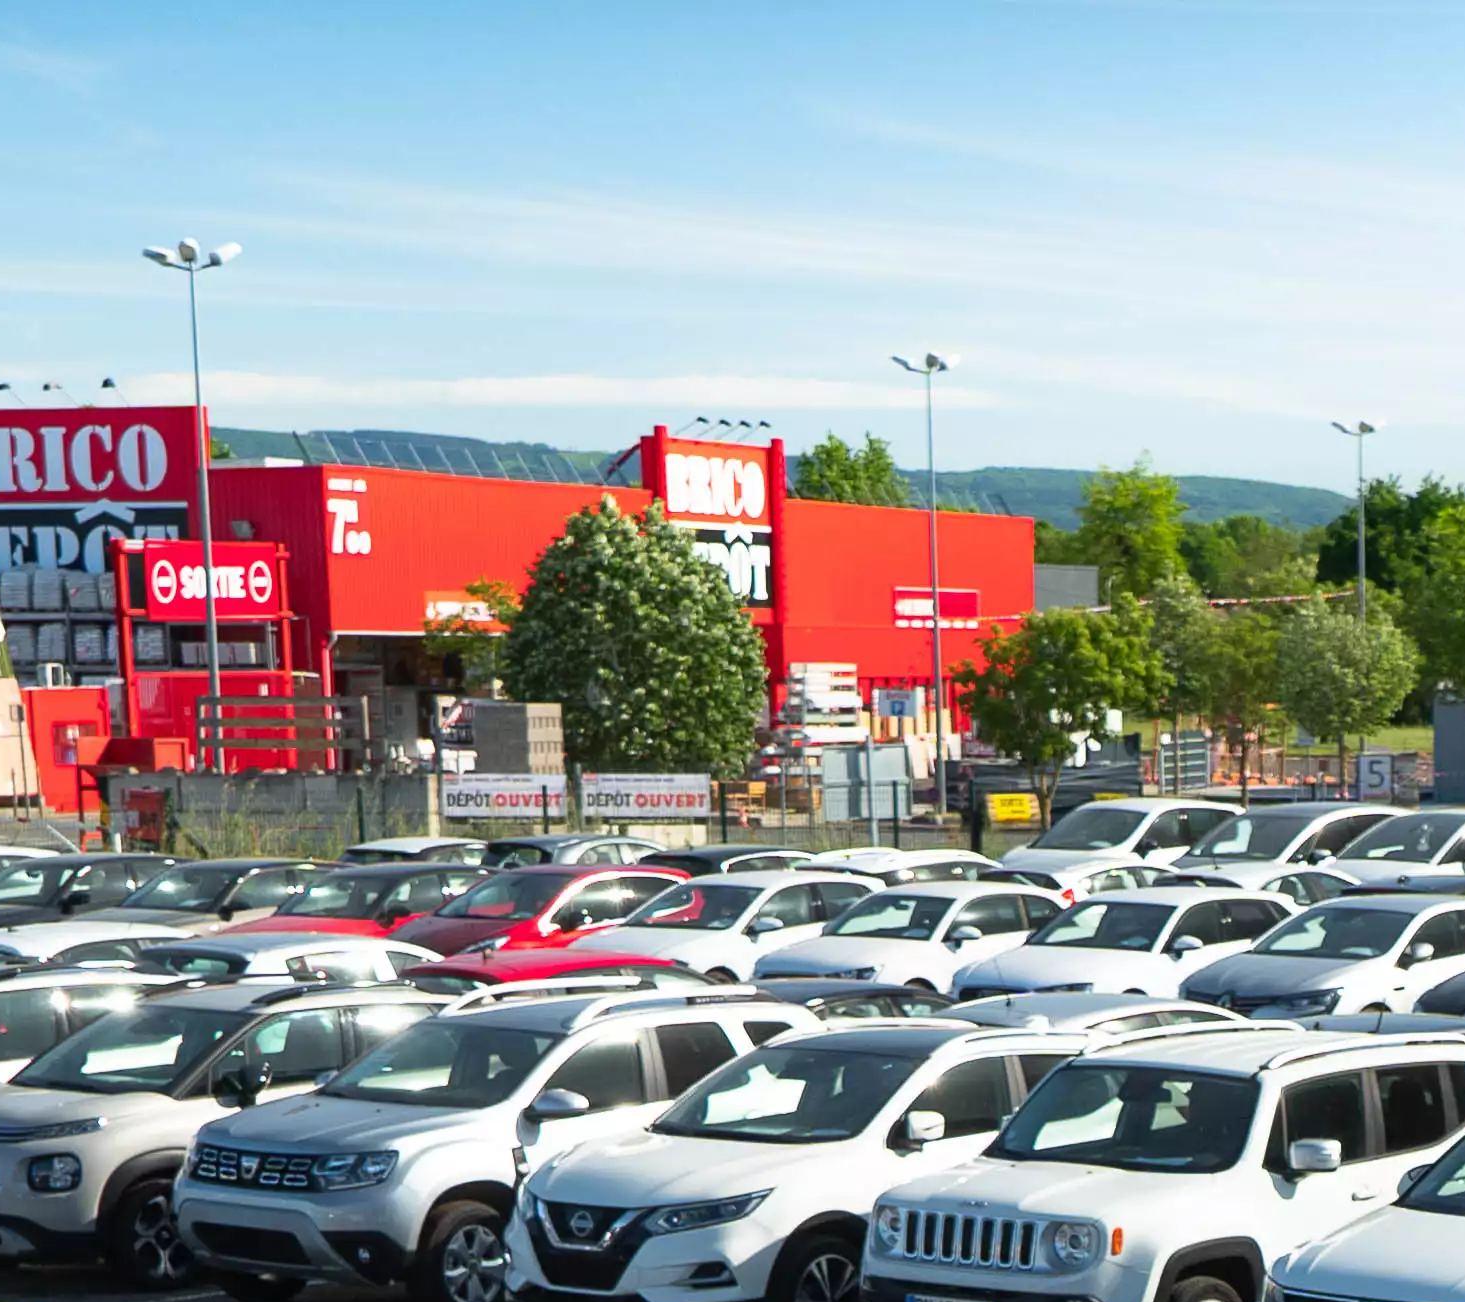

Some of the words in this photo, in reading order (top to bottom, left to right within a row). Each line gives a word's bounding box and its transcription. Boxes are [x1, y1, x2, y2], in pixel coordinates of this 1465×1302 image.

[665, 453, 765, 518] BRICO
[1368, 760, 1385, 788] 5
[446, 789, 491, 808] DÉPÔT
[586, 789, 631, 808] DÉPÔT
[633, 793, 706, 808] OUVERT
